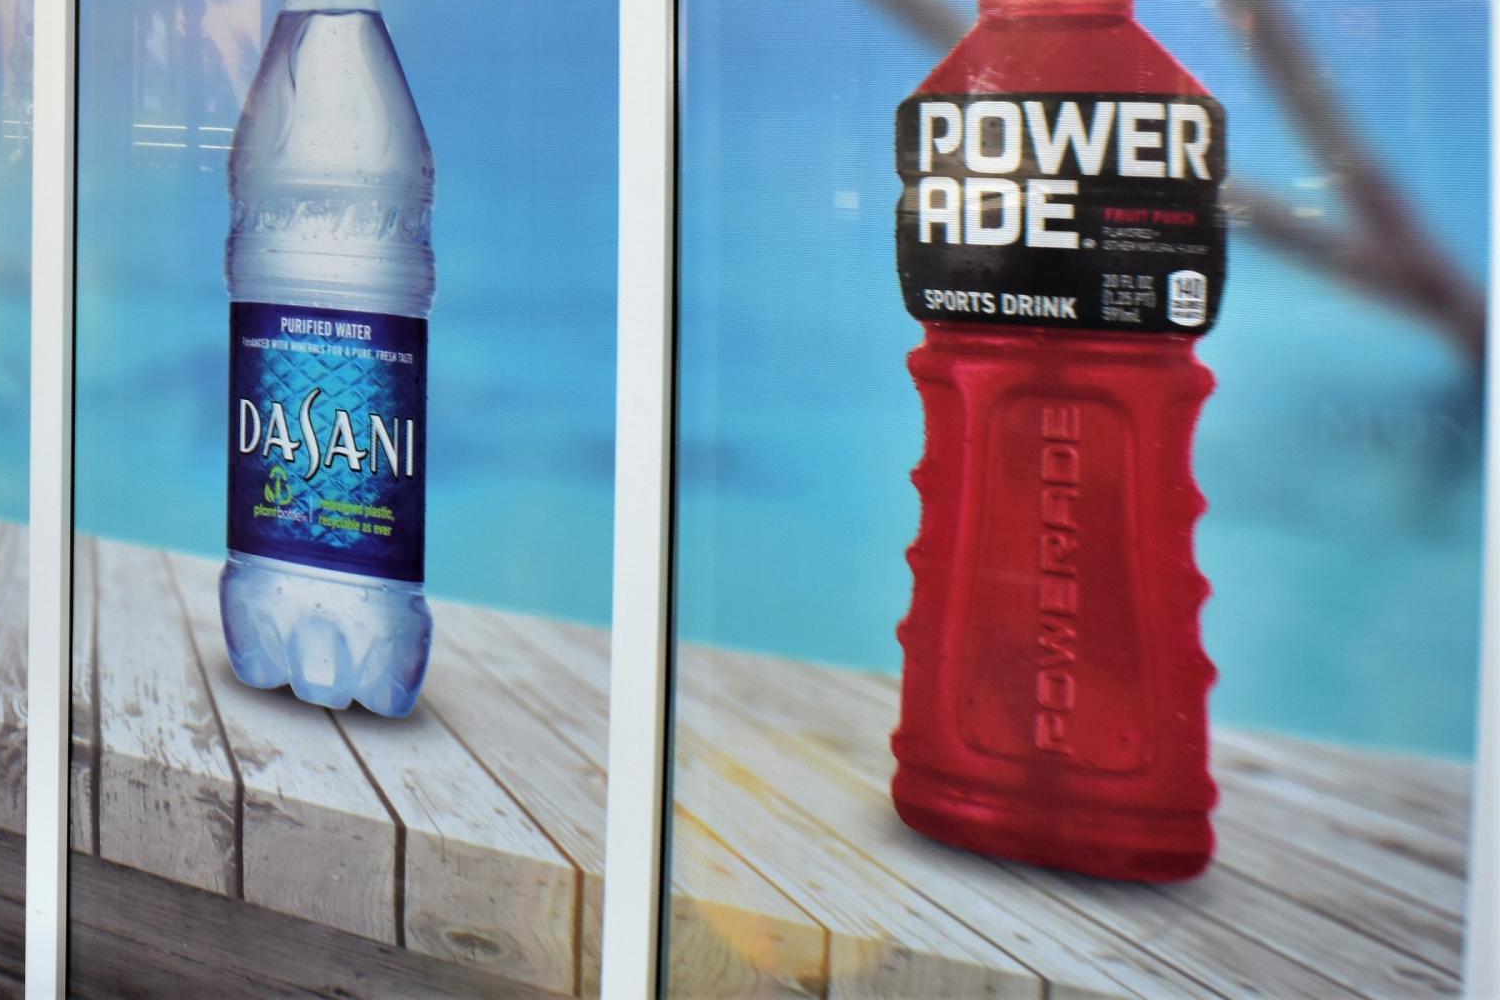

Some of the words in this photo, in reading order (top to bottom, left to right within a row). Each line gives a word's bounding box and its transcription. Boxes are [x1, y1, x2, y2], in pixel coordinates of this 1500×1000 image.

[918, 100, 1212, 181] POWER
[280, 317, 332, 337] PURIFIED
[335, 322, 372, 341] WATER
[924, 289, 996, 316] SPORTS
[1002, 293, 1077, 320] DRINK
[239, 387, 414, 481] DASANI
[1034, 406, 1080, 755] POWERADE
